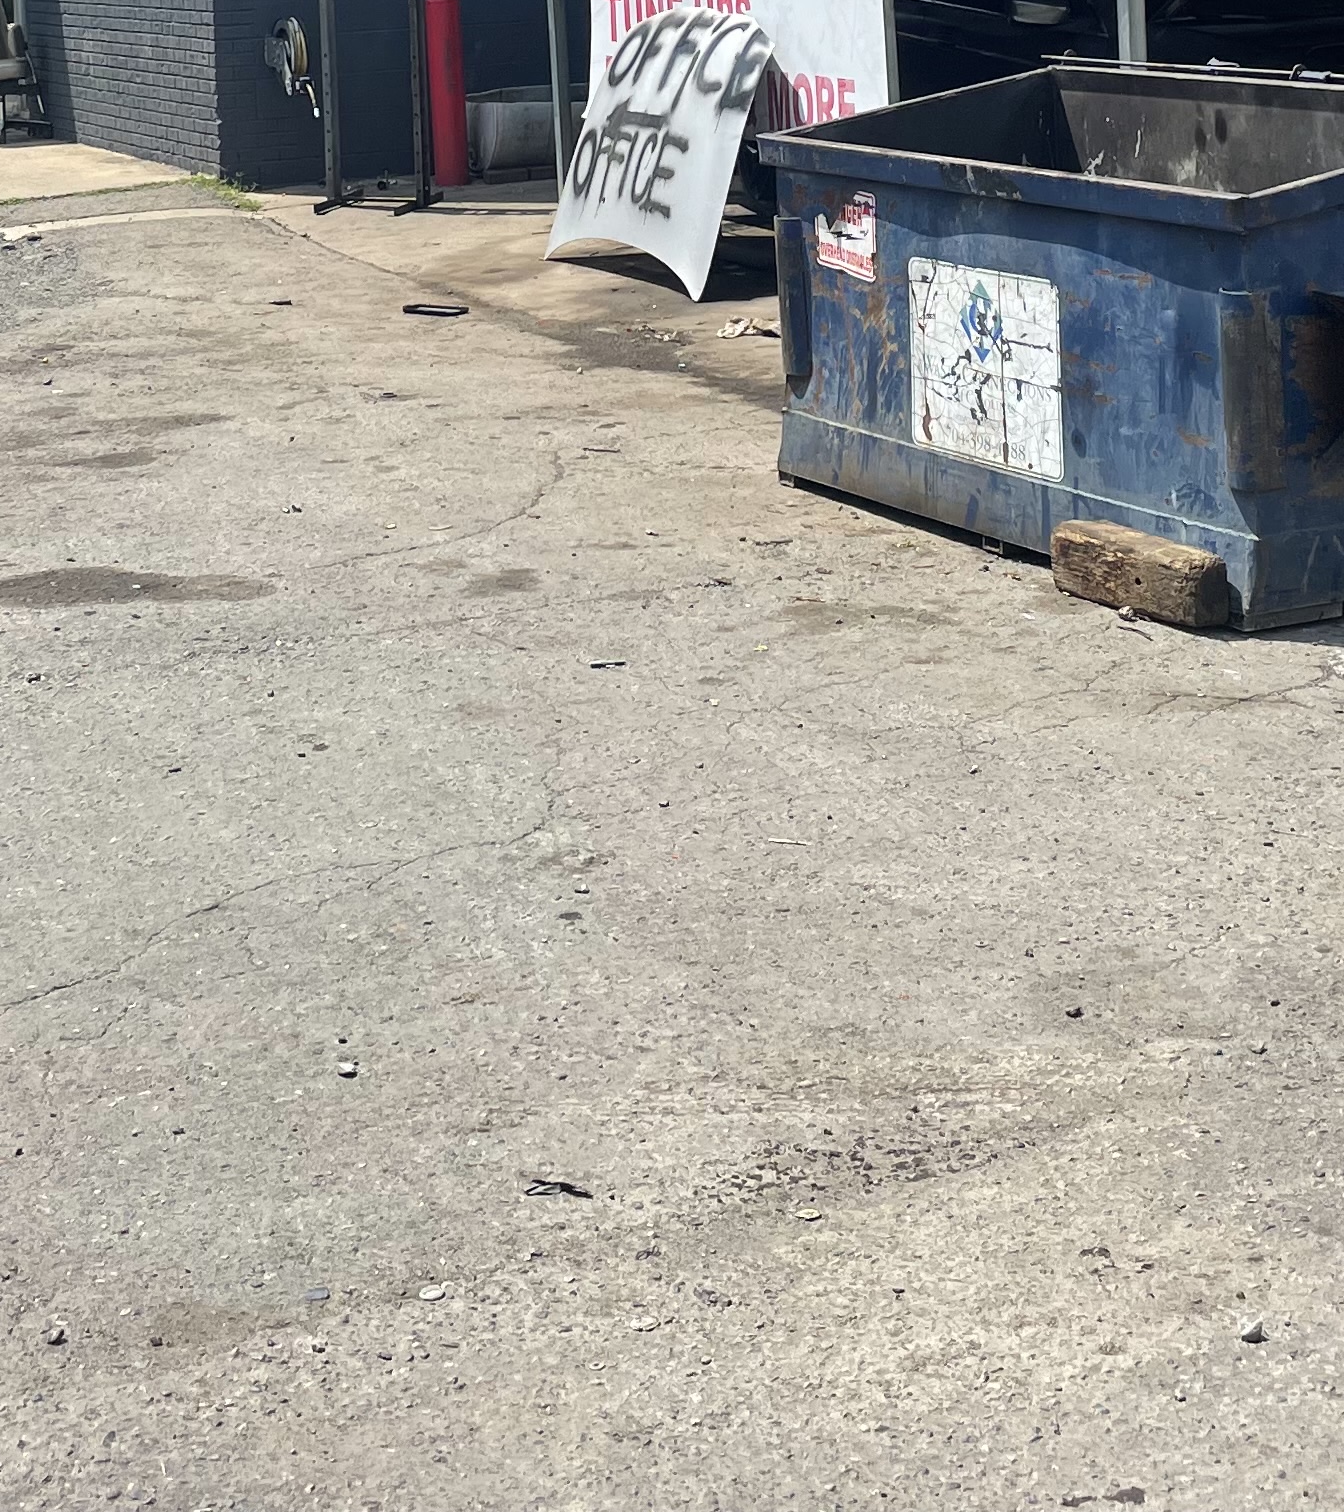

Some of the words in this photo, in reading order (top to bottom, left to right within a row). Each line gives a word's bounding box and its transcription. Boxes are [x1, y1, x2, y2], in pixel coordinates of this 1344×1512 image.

[608, 9, 773, 113] OFFICE
[766, 70, 855, 131] MORE
[573, 126, 689, 220] OFFICE
